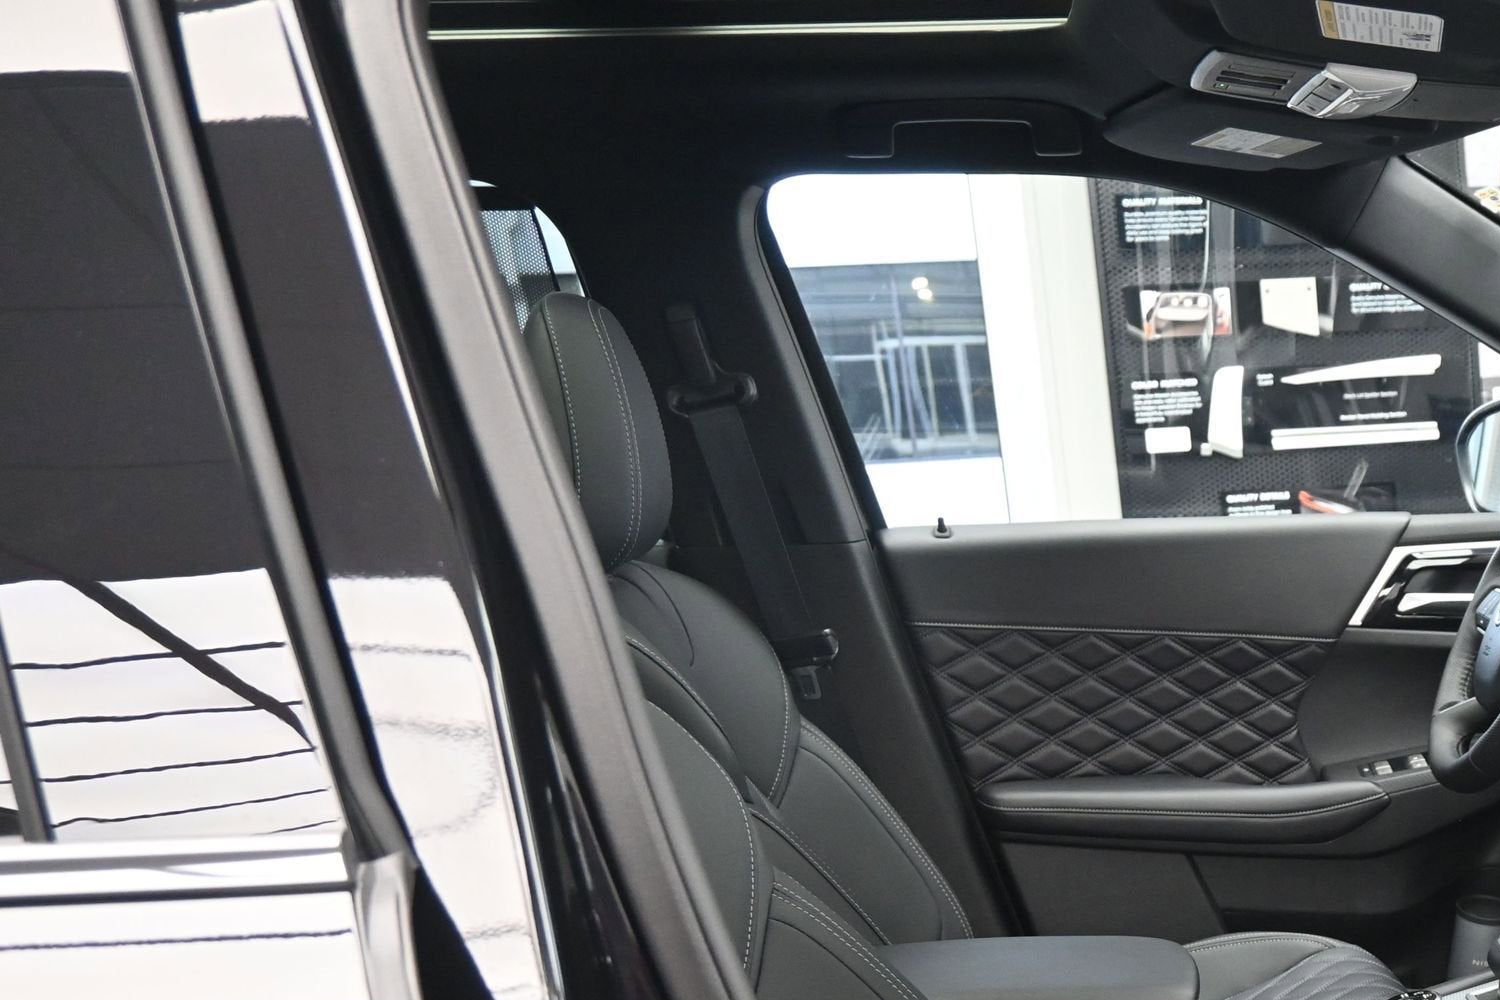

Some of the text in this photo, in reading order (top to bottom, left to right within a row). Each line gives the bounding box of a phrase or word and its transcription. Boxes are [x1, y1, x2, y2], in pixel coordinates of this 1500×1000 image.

[1122, 197, 1157, 208] QUALITY
[1349, 282, 1383, 293] QUALITY
[1226, 492, 1259, 504] QUALITY
